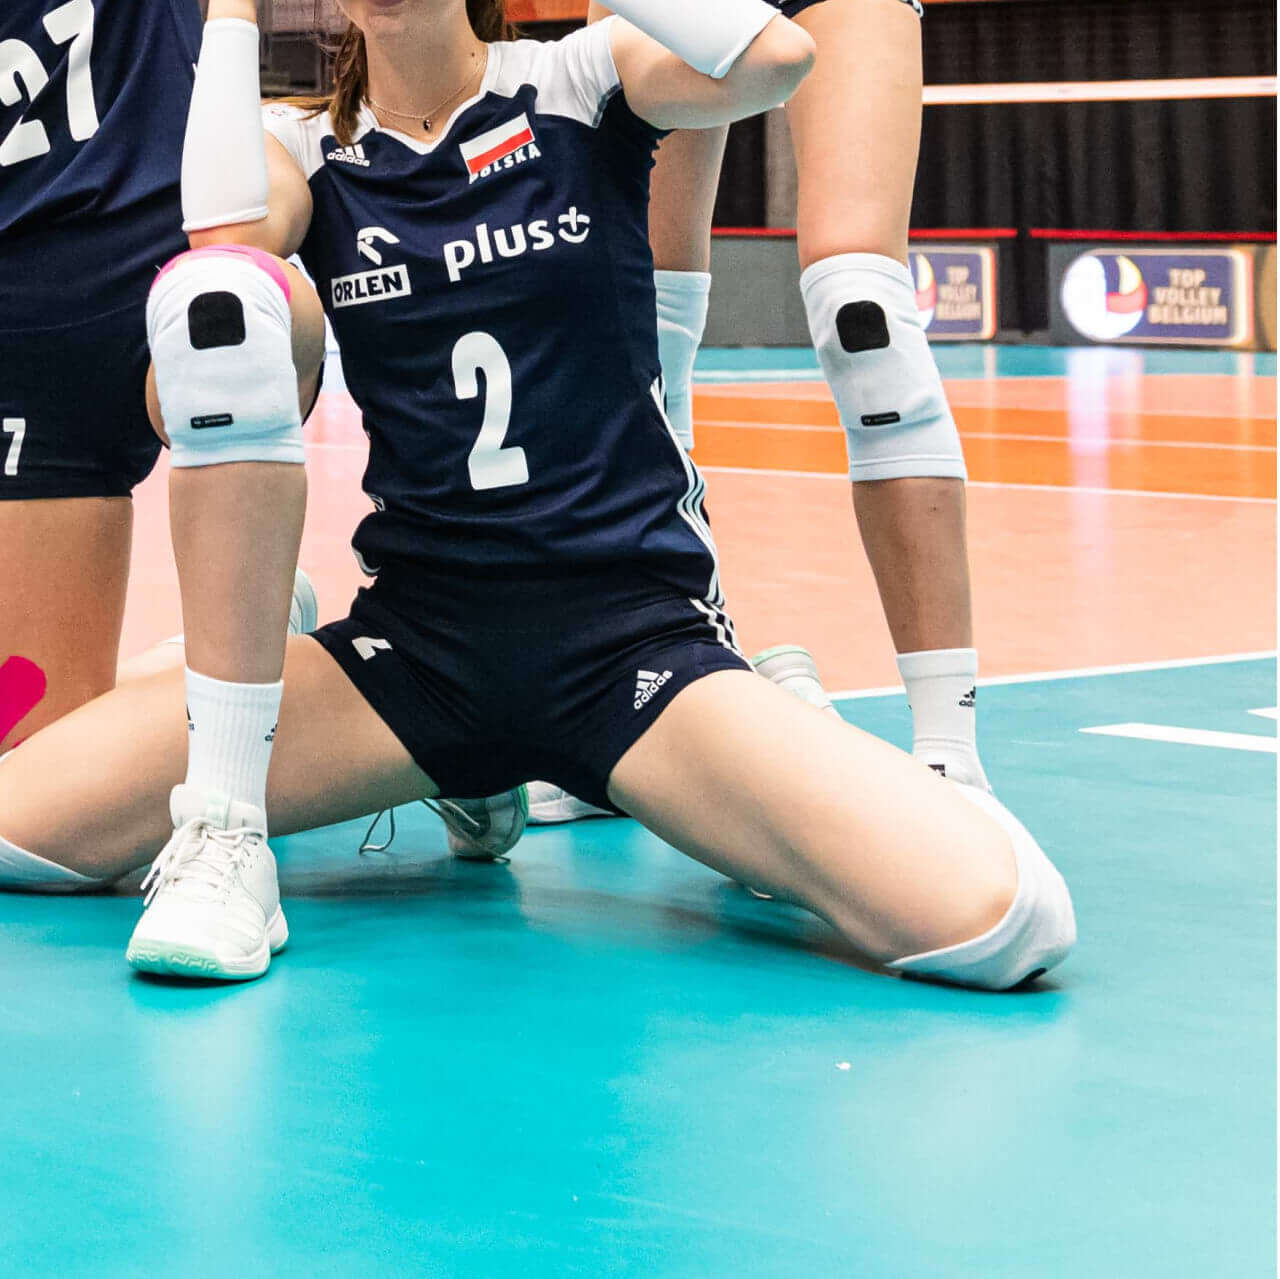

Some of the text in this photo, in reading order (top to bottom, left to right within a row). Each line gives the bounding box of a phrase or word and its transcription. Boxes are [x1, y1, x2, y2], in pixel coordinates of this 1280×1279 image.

[468, 143, 542, 184] POLSKA
[443, 218, 554, 283] plus
[334, 271, 403, 303] ORLEN
[1154, 287, 1222, 305] VOLLEY
[1169, 268, 1206, 288] TOP
[1148, 305, 1228, 325] BELGIUM
[451, 331, 530, 490] 2
[633, 670, 674, 710] adidas
